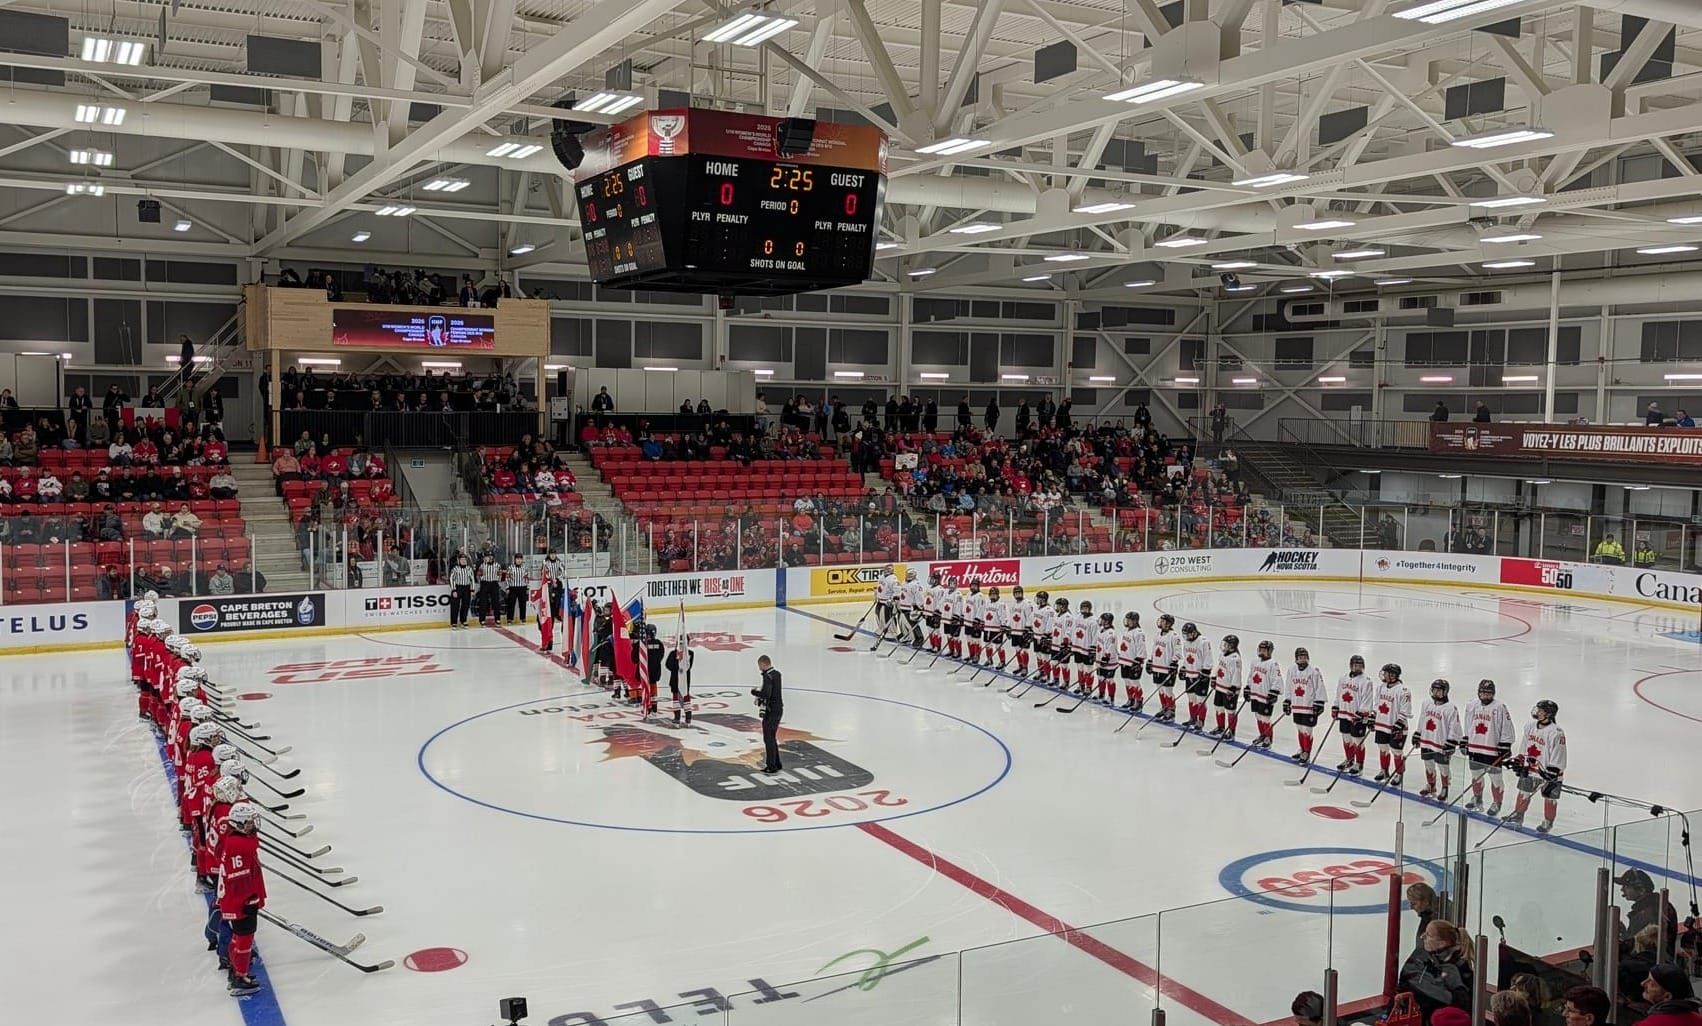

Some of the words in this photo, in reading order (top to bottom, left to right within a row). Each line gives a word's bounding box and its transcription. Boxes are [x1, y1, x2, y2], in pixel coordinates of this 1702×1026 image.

[627, 164, 644, 181] GUEST
[706, 161, 739, 177] HOME
[770, 167, 813, 191] 2:25
[830, 173, 864, 188] GUEST
[721, 183, 733, 205] 0
[761, 200, 787, 210] PERIOD
[790, 200, 798, 215] 0
[846, 194, 857, 215] 0
[692, 211, 711, 221] PLYR
[716, 213, 748, 224] PENALTY
[814, 220, 832, 231] PLYR
[837, 222, 867, 232] PENALTY
[764, 240, 773, 254] 0
[795, 241, 804, 256] 0
[750, 259, 774, 269] SHOTS
[775, 260, 785, 269] ON
[787, 260, 806, 270] GOAL
[1523, 433, 1559, 449] VOYEZ-Y
[1559, 434, 1576, 449] LES
[1578, 435, 1602, 451] PLUS
[1603, 435, 1657, 453] BRILLANTS
[1170, 557, 1186, 566] 270
[1187, 556, 1212, 565] WEST
[1276, 551, 1319, 563] HOCKEY
[963, 564, 1017, 584] Hortons
[1074, 561, 1124, 575] TELUS
[1169, 564, 1212, 573] CONSULTING
[1276, 562, 1293, 571] NOVA
[1293, 562, 1317, 571] SCOTIA
[1396, 561, 1477, 574] #Together4Integrity
[827, 569, 859, 584] OK
[1541, 568, 1556, 584] 50
[1556, 572, 1573, 589] 50
[647, 579, 688, 597] TOGETHER
[689, 579, 702, 594] WE
[704, 578, 722, 593] RISE
[722, 579, 730, 590] AS
[730, 576, 744, 592] ONE
[1635, 572, 1702, 604] Cana
[220, 603, 249, 613] CAPE
[250, 601, 293, 612] BRETON
[394, 595, 451, 609] TISSO
[225, 610, 288, 621] BEVERAGES
[0, 614, 88, 633] ELUS
[197, 766, 209, 779] 25
[718, 764, 844, 790] IIHF
[742, 790, 908, 823] 2026
[232, 855, 243, 869] 16
[300, 927, 336, 948] BAUER
